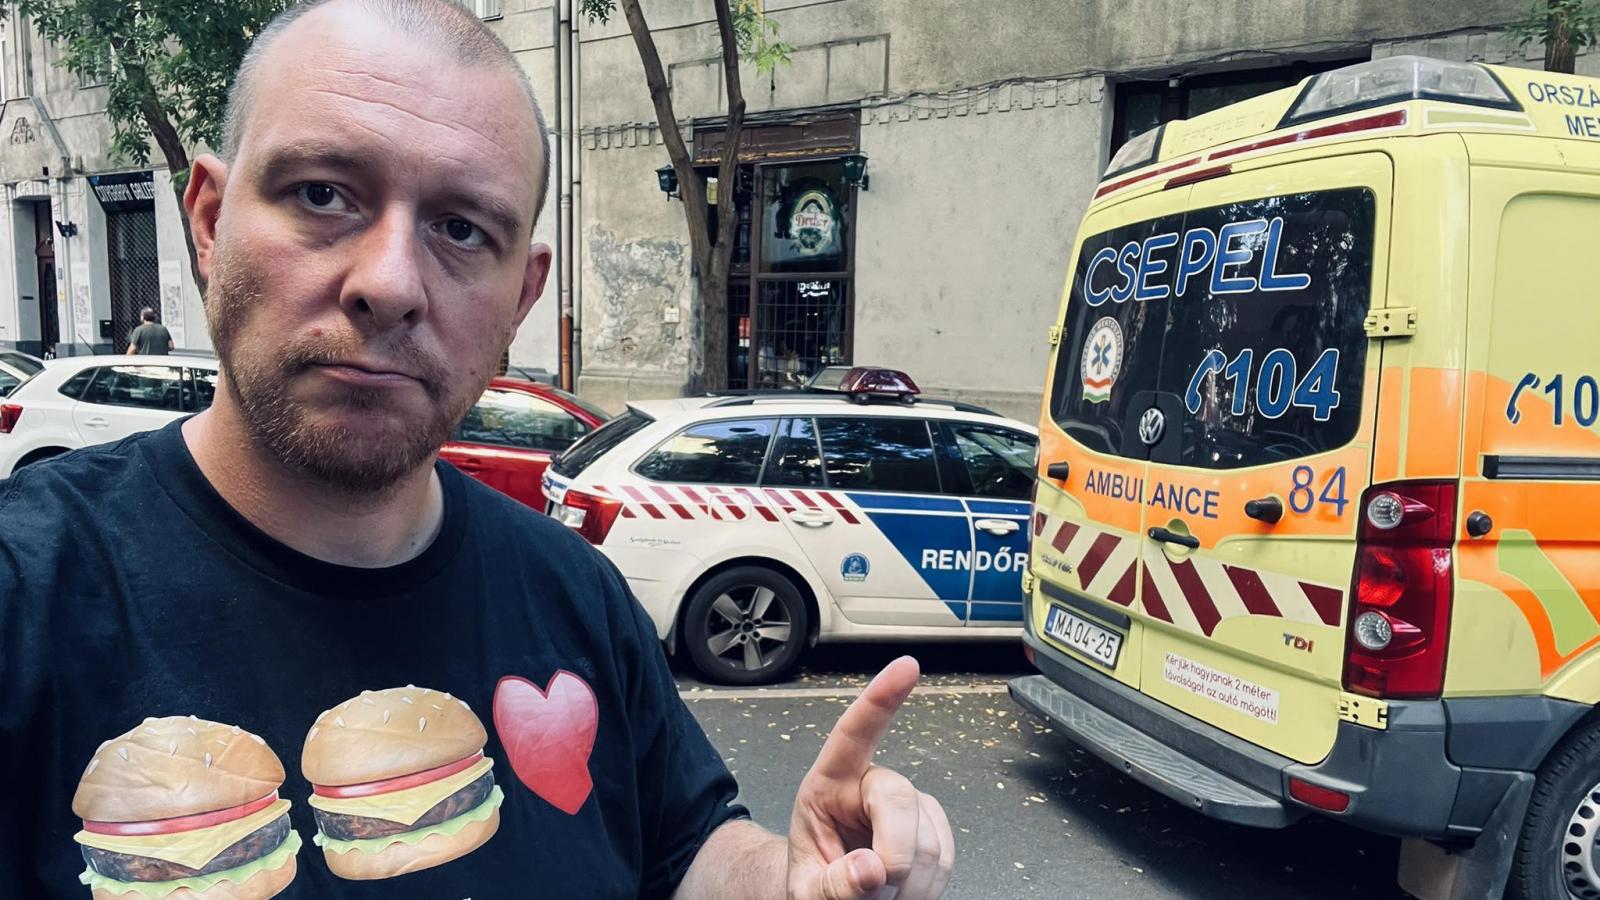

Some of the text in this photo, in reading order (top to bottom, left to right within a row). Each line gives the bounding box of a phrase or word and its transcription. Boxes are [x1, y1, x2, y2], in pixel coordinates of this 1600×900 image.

[1565, 114, 1600, 137] ME
[1084, 217, 1312, 307] CSEPEL
[1225, 347, 1341, 422] 104
[1085, 469, 1220, 519] AMBULANCE
[1288, 465, 1350, 517] 84
[1283, 632, 1314, 653] TDI
[1165, 653, 1271, 701] Kérjük hagyjanak 2 méter
[1165, 669, 1205, 693] távolságot
[1206, 687, 1217, 699] az
[1218, 691, 1239, 706] autó
